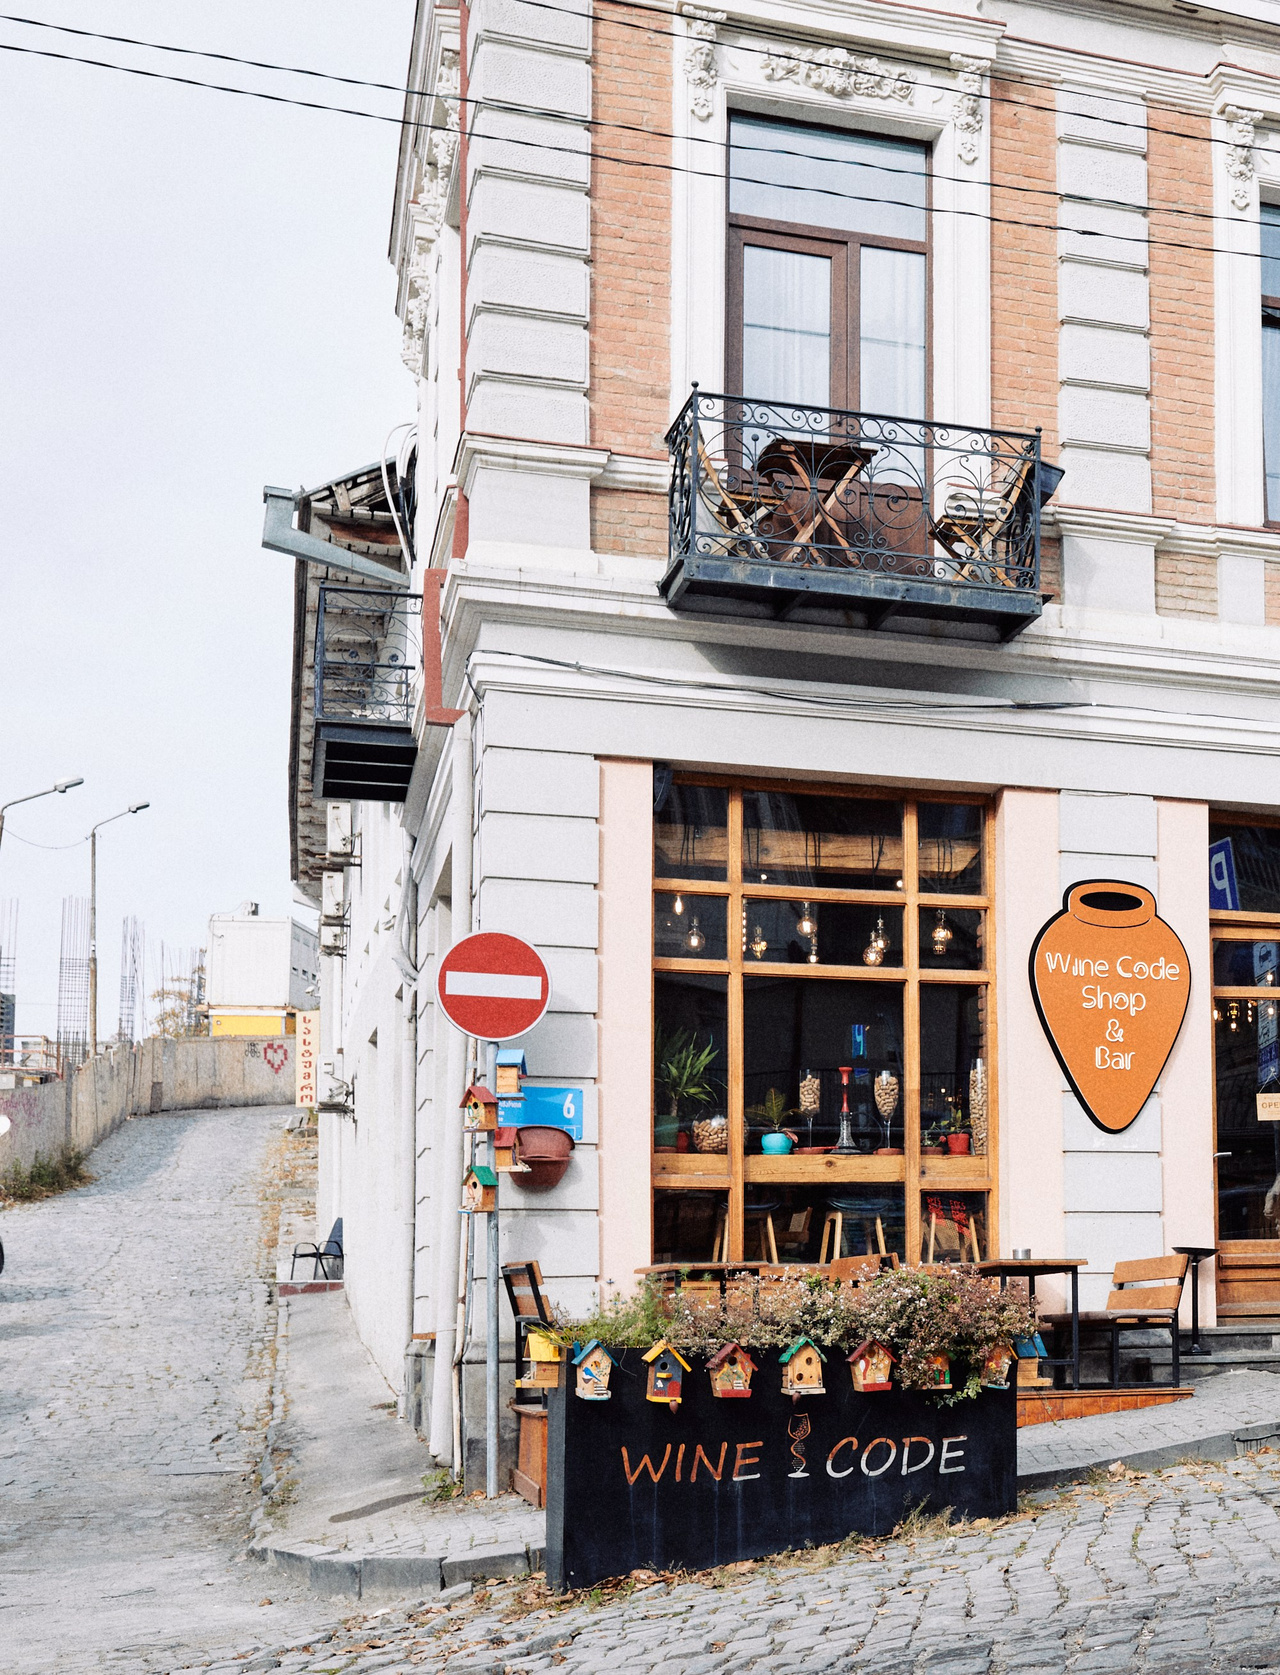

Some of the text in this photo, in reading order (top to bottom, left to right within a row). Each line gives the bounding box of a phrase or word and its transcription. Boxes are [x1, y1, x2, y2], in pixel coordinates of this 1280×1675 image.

[1046, 952, 1180, 980] Wine Code
[1082, 985, 1146, 1017] Shop
[1105, 1018, 1124, 1042] &
[300, 1015, 313, 1103] სასტუმრო
[1095, 1045, 1135, 1070] Bar
[563, 1093, 575, 1119] 6
[620, 1435, 968, 1486] WINE CODE
